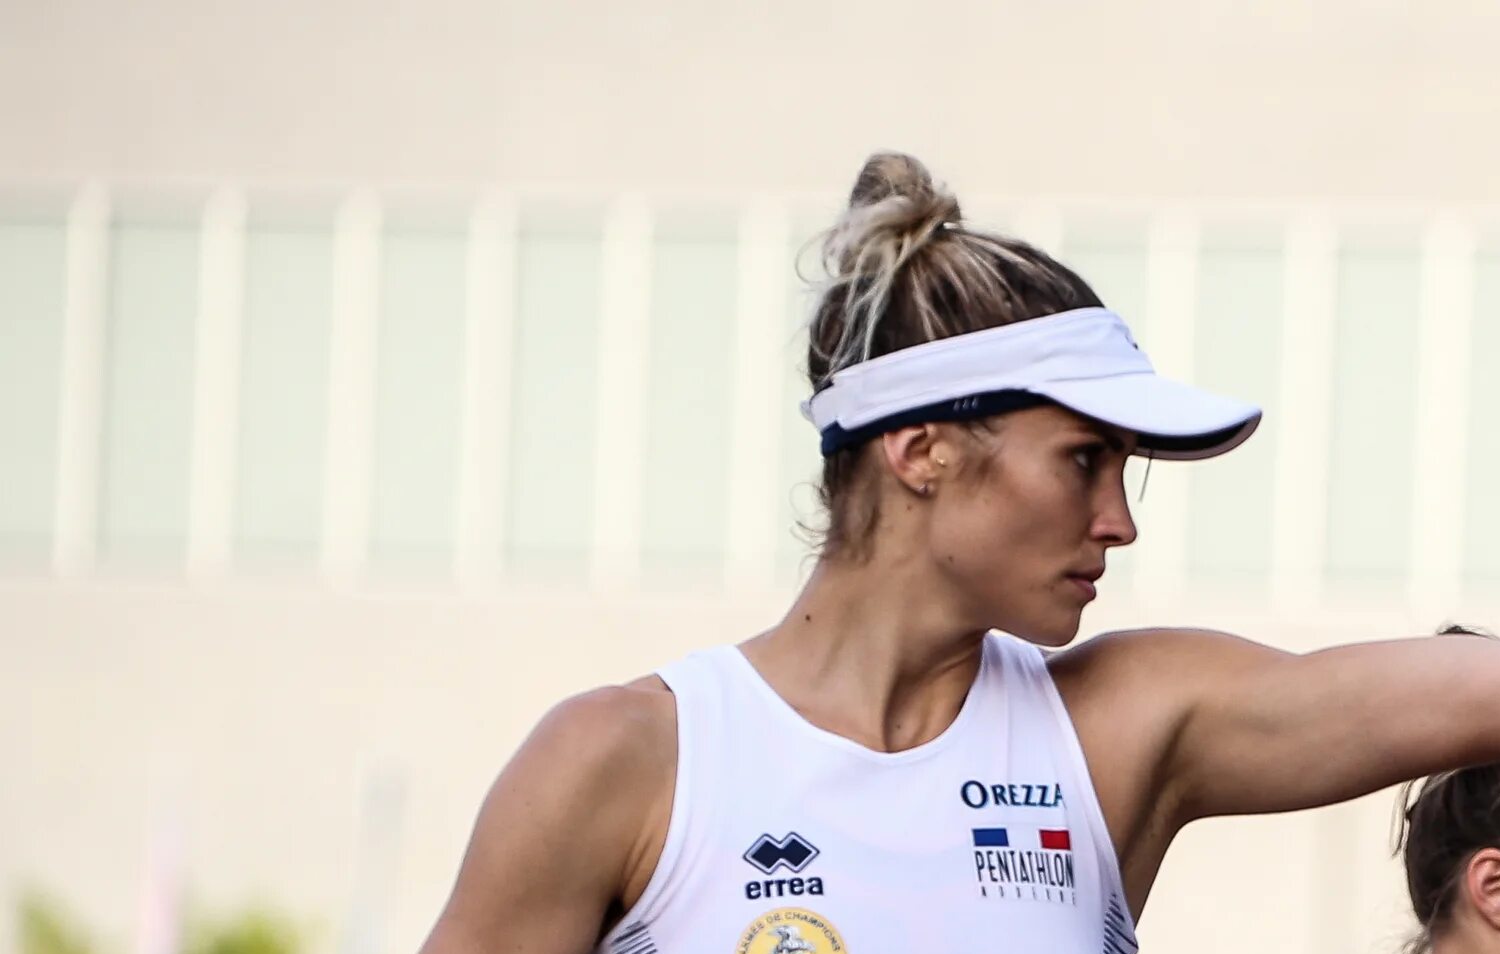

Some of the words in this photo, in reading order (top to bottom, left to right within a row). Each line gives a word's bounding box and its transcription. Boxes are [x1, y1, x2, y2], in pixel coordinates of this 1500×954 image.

[960, 780, 1063, 809] OREZZA
[975, 850, 1075, 888] PENTATHLON
[745, 877, 824, 900] errea
[784, 911, 841, 952] CHAMPIONS
